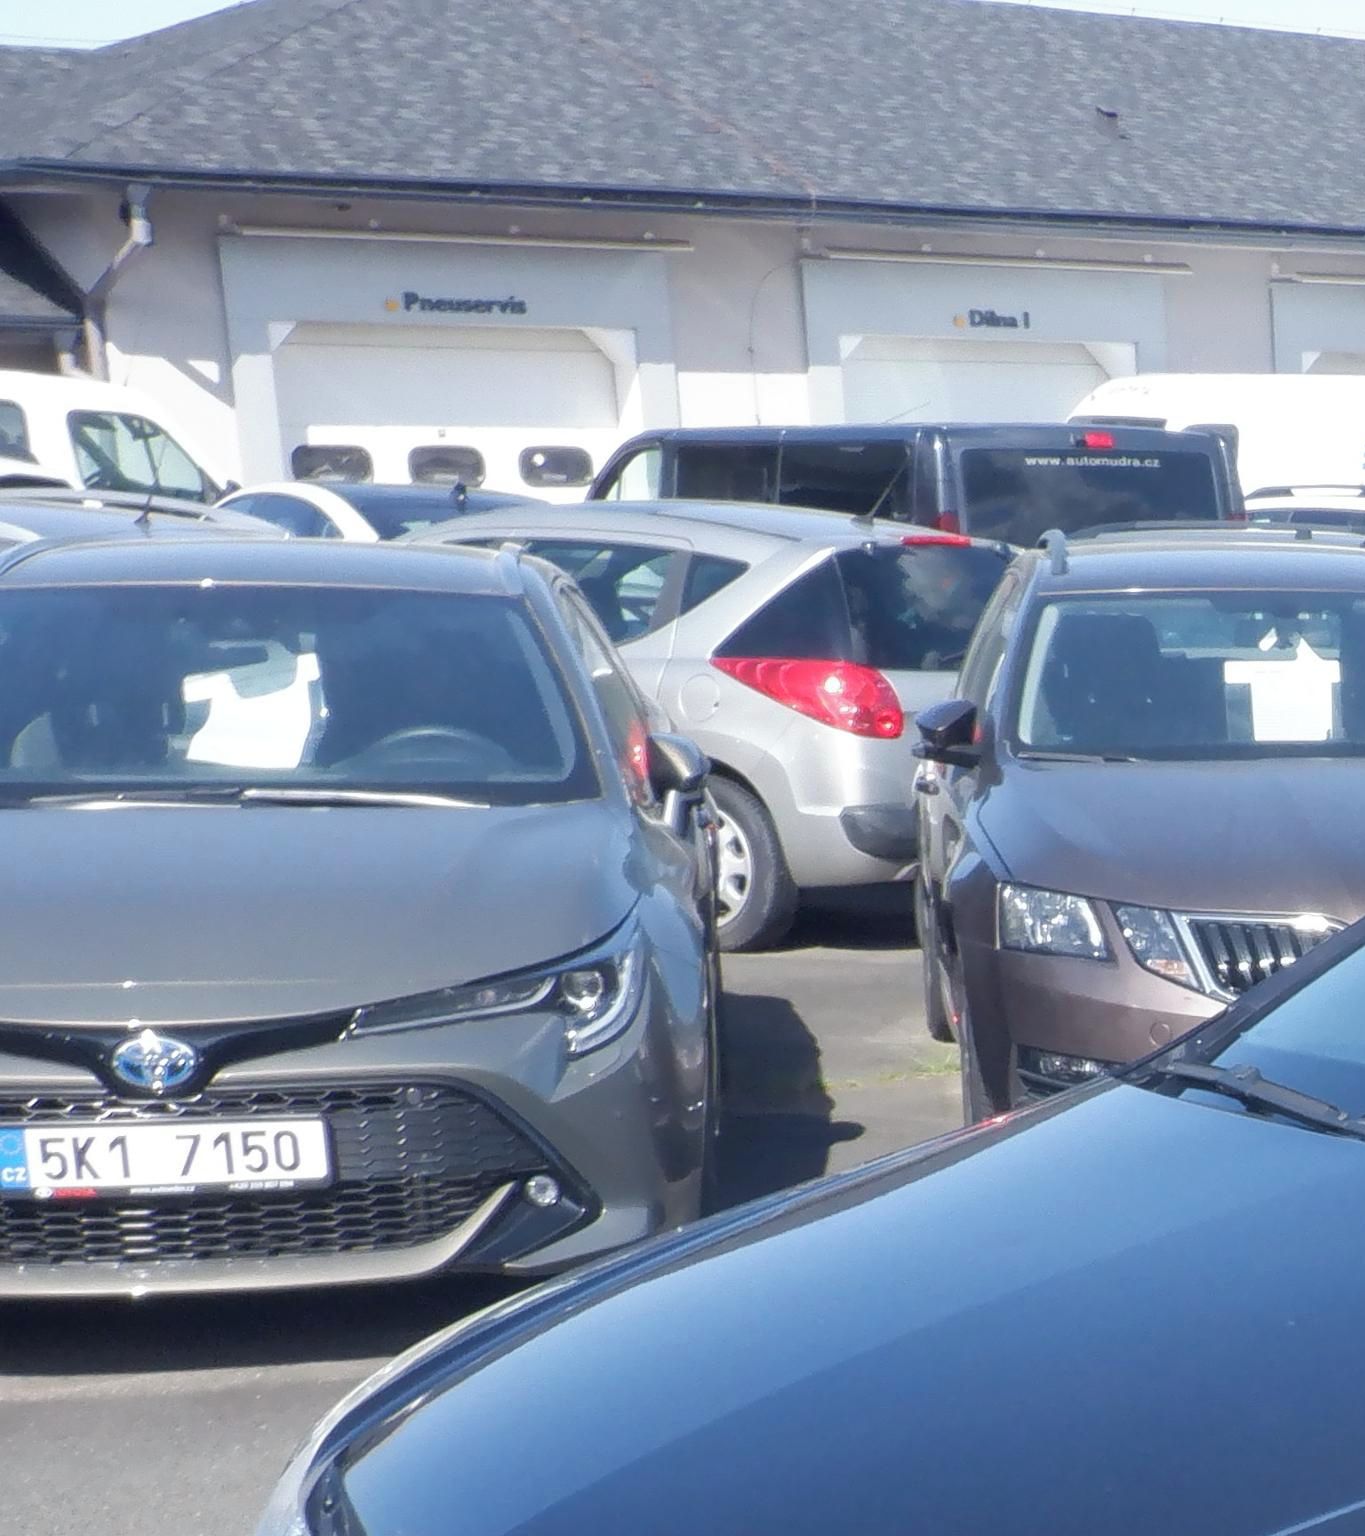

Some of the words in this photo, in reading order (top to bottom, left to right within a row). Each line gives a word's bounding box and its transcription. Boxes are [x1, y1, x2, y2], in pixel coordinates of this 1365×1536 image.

[39, 1134, 131, 1181] 5K1
[175, 1130, 302, 1177] 7150
[2, 1167, 27, 1182] CZ
